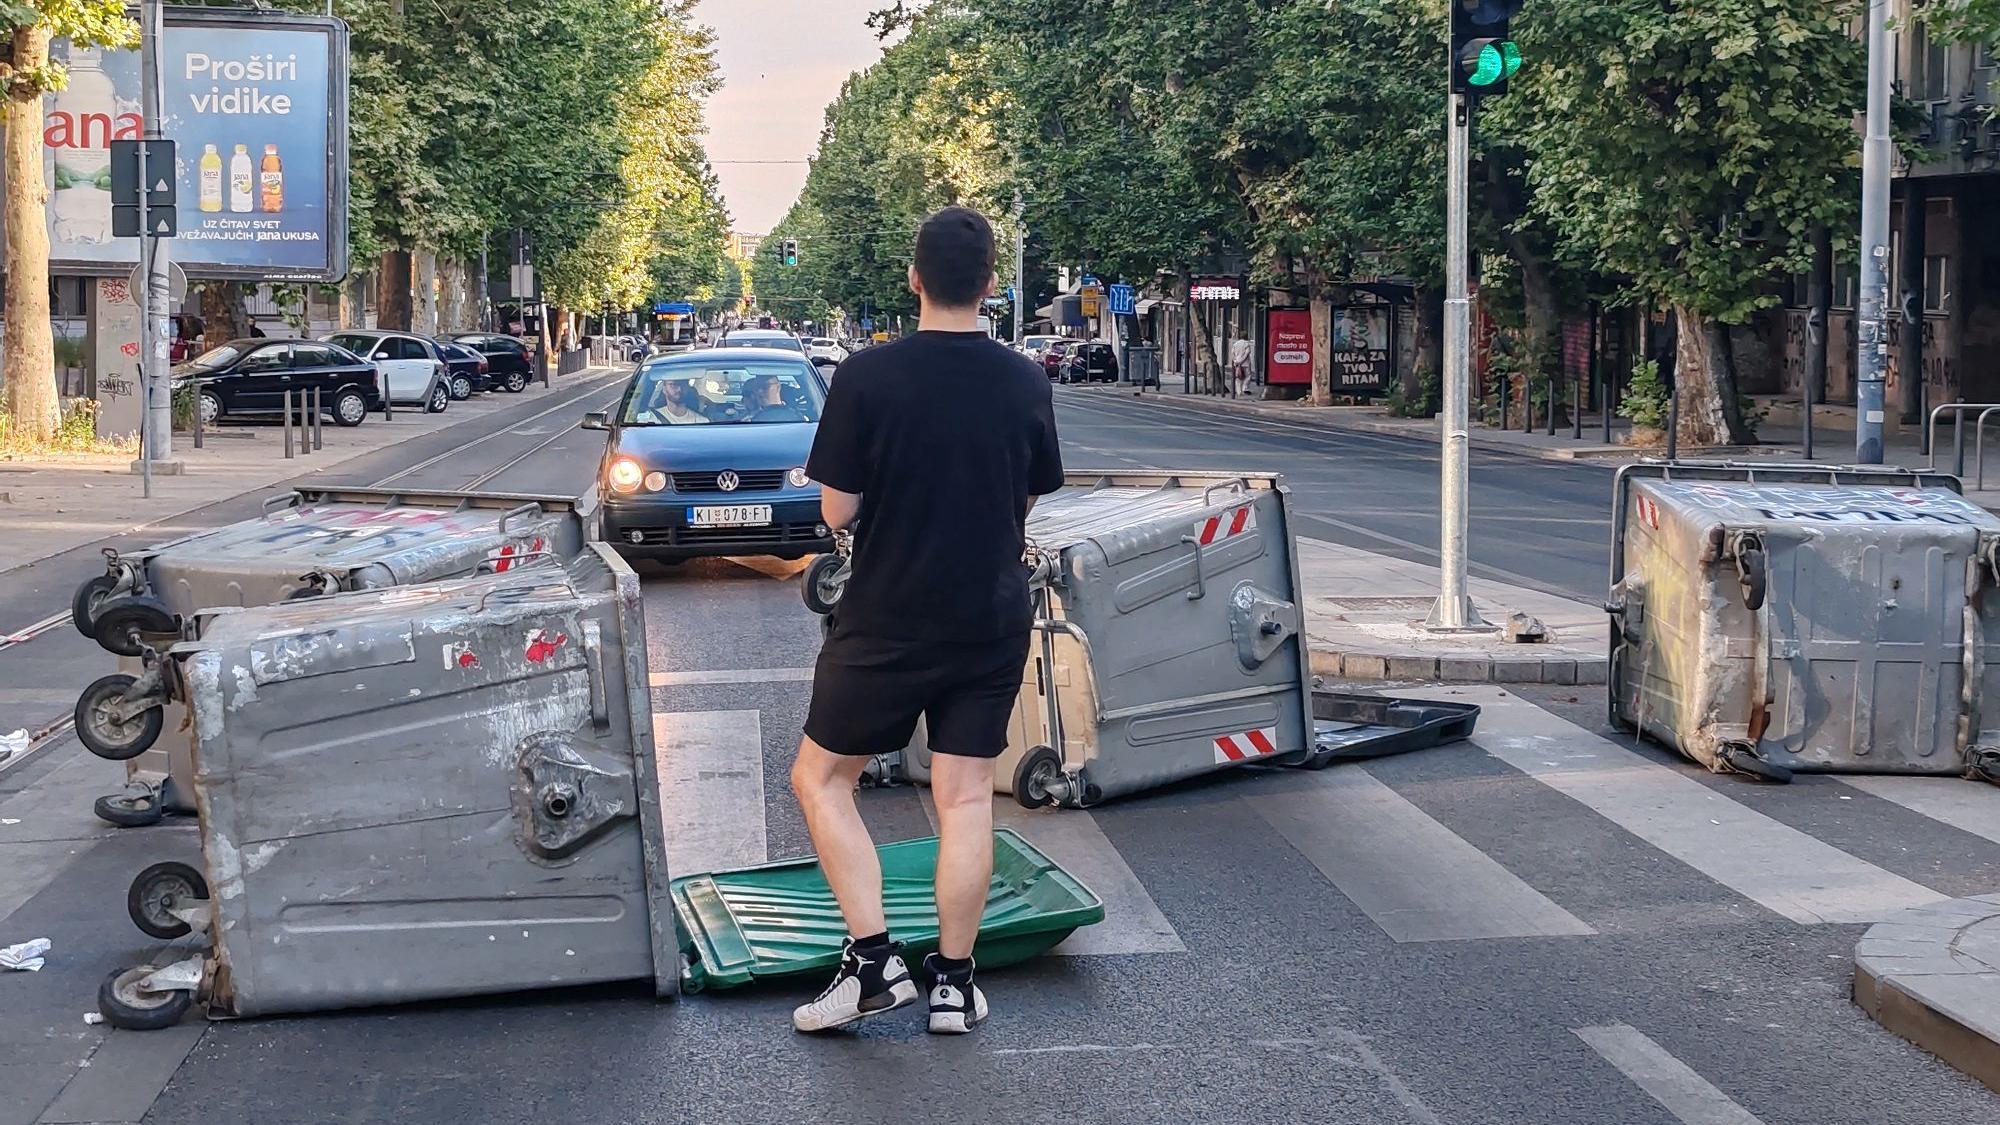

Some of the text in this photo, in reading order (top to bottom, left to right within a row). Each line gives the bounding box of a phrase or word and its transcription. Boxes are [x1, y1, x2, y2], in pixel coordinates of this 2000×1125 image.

[186, 52, 297, 81] Proširi
[190, 86, 292, 115] vidike
[43, 111, 145, 149] ana
[203, 217, 281, 229] UZ ČITAV SVET
[175, 229, 254, 241] SVEŽAVAJUĆIH
[282, 231, 320, 241] UKUSA
[1334, 351, 1386, 362] KAFA ZA
[1344, 363, 1374, 374] TVOJ
[1342, 374, 1379, 384] RITAM
[696, 508, 711, 522] KI
